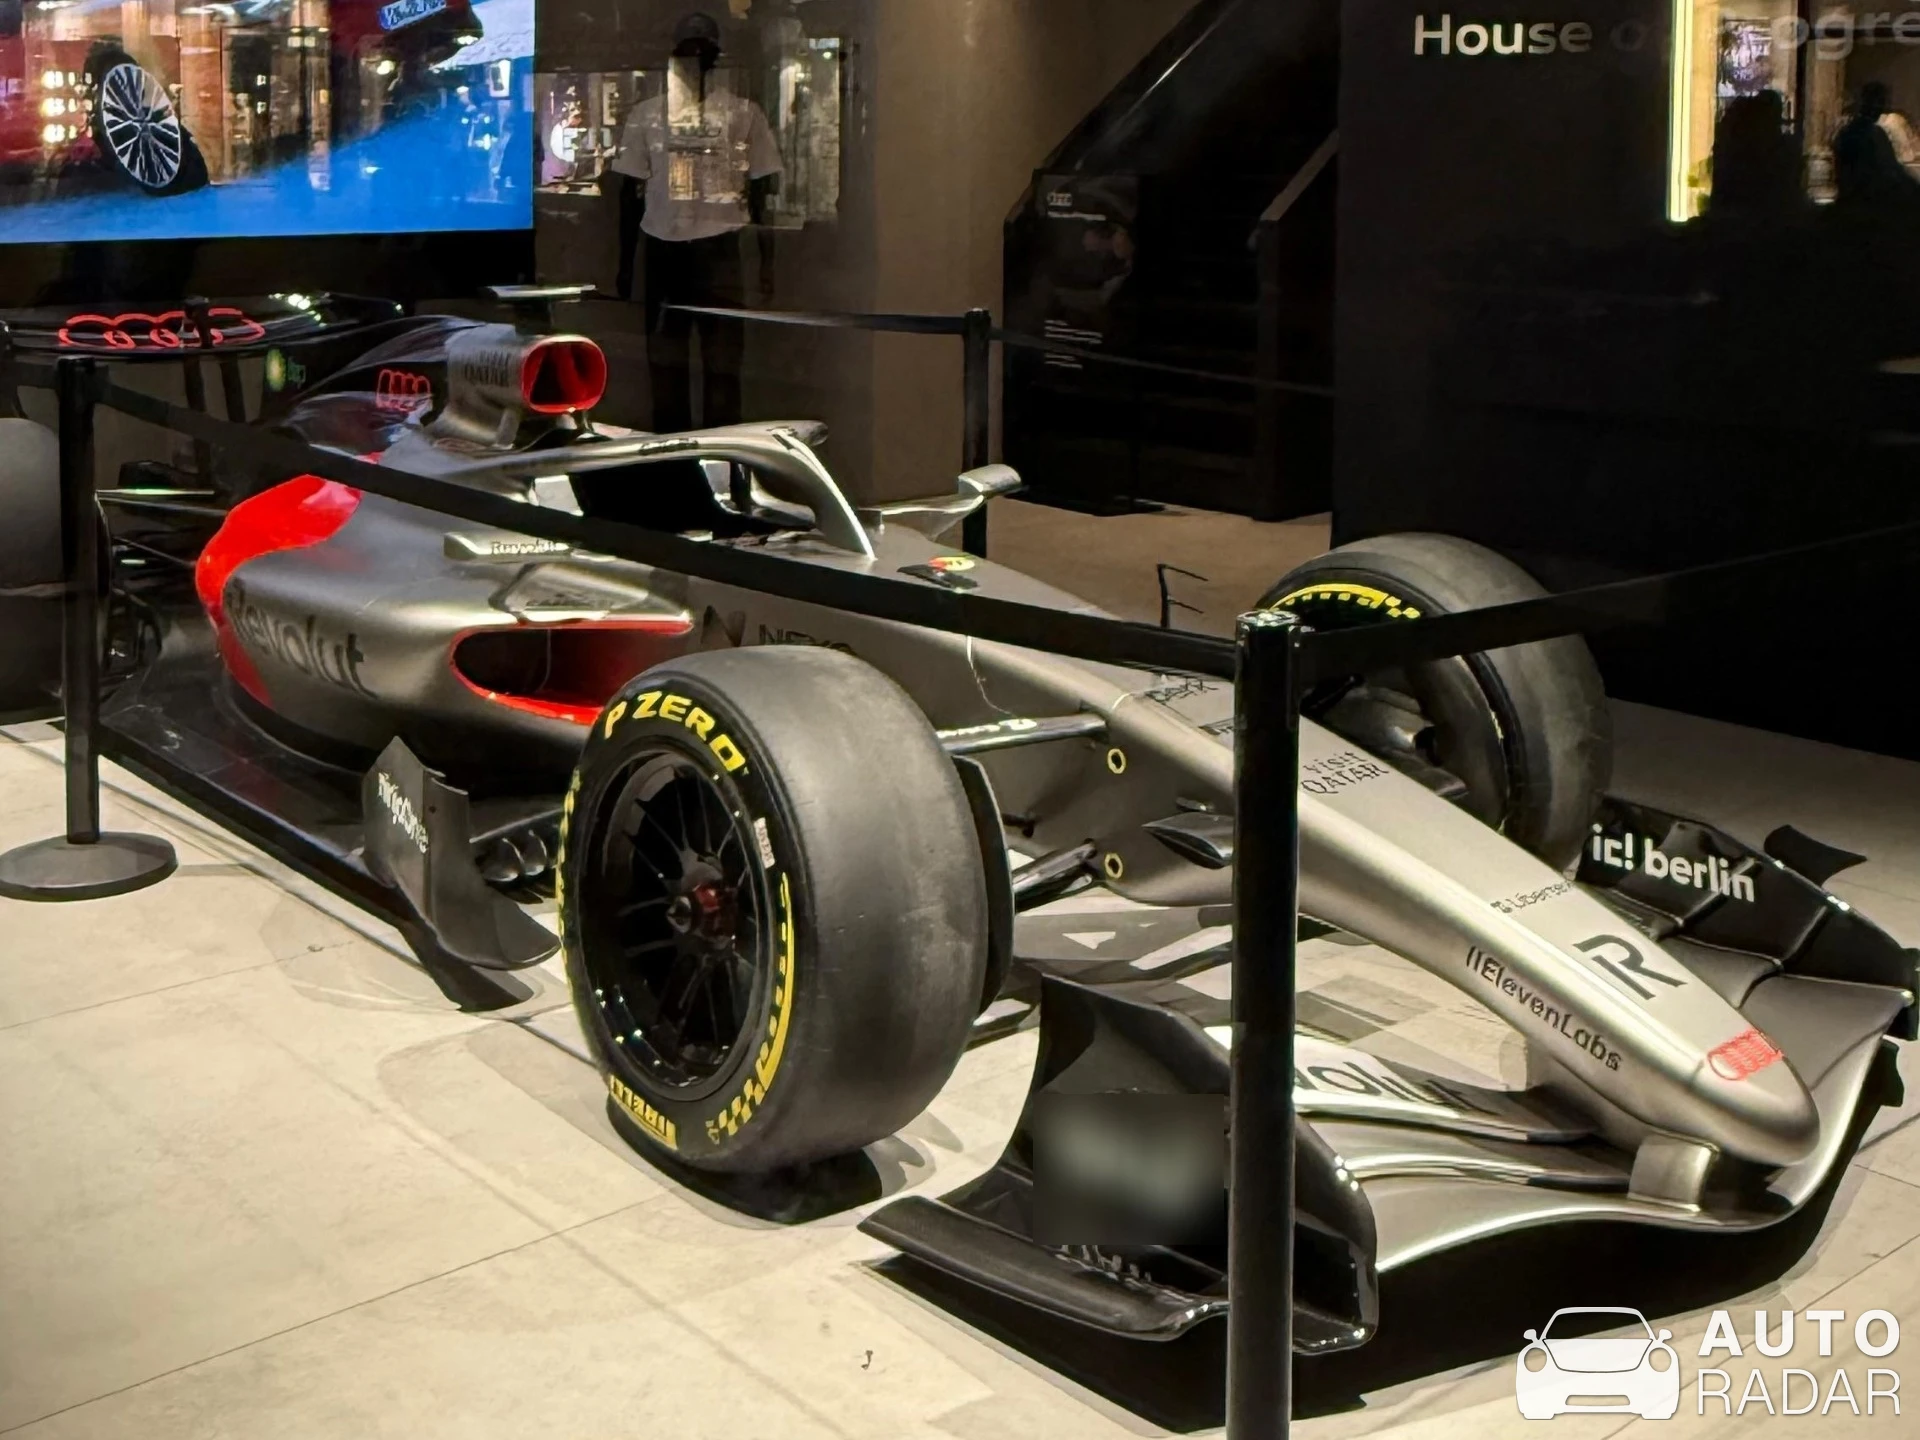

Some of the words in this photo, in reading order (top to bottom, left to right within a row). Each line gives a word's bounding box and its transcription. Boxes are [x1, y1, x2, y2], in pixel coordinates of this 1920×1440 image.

[1414, 13, 1593, 56] House
[603, 700, 628, 740] P
[631, 690, 747, 773] ZERO
[1300, 762, 1390, 794] QATAR
[1592, 823, 1634, 871] ic!
[1643, 837, 1755, 903] berlin
